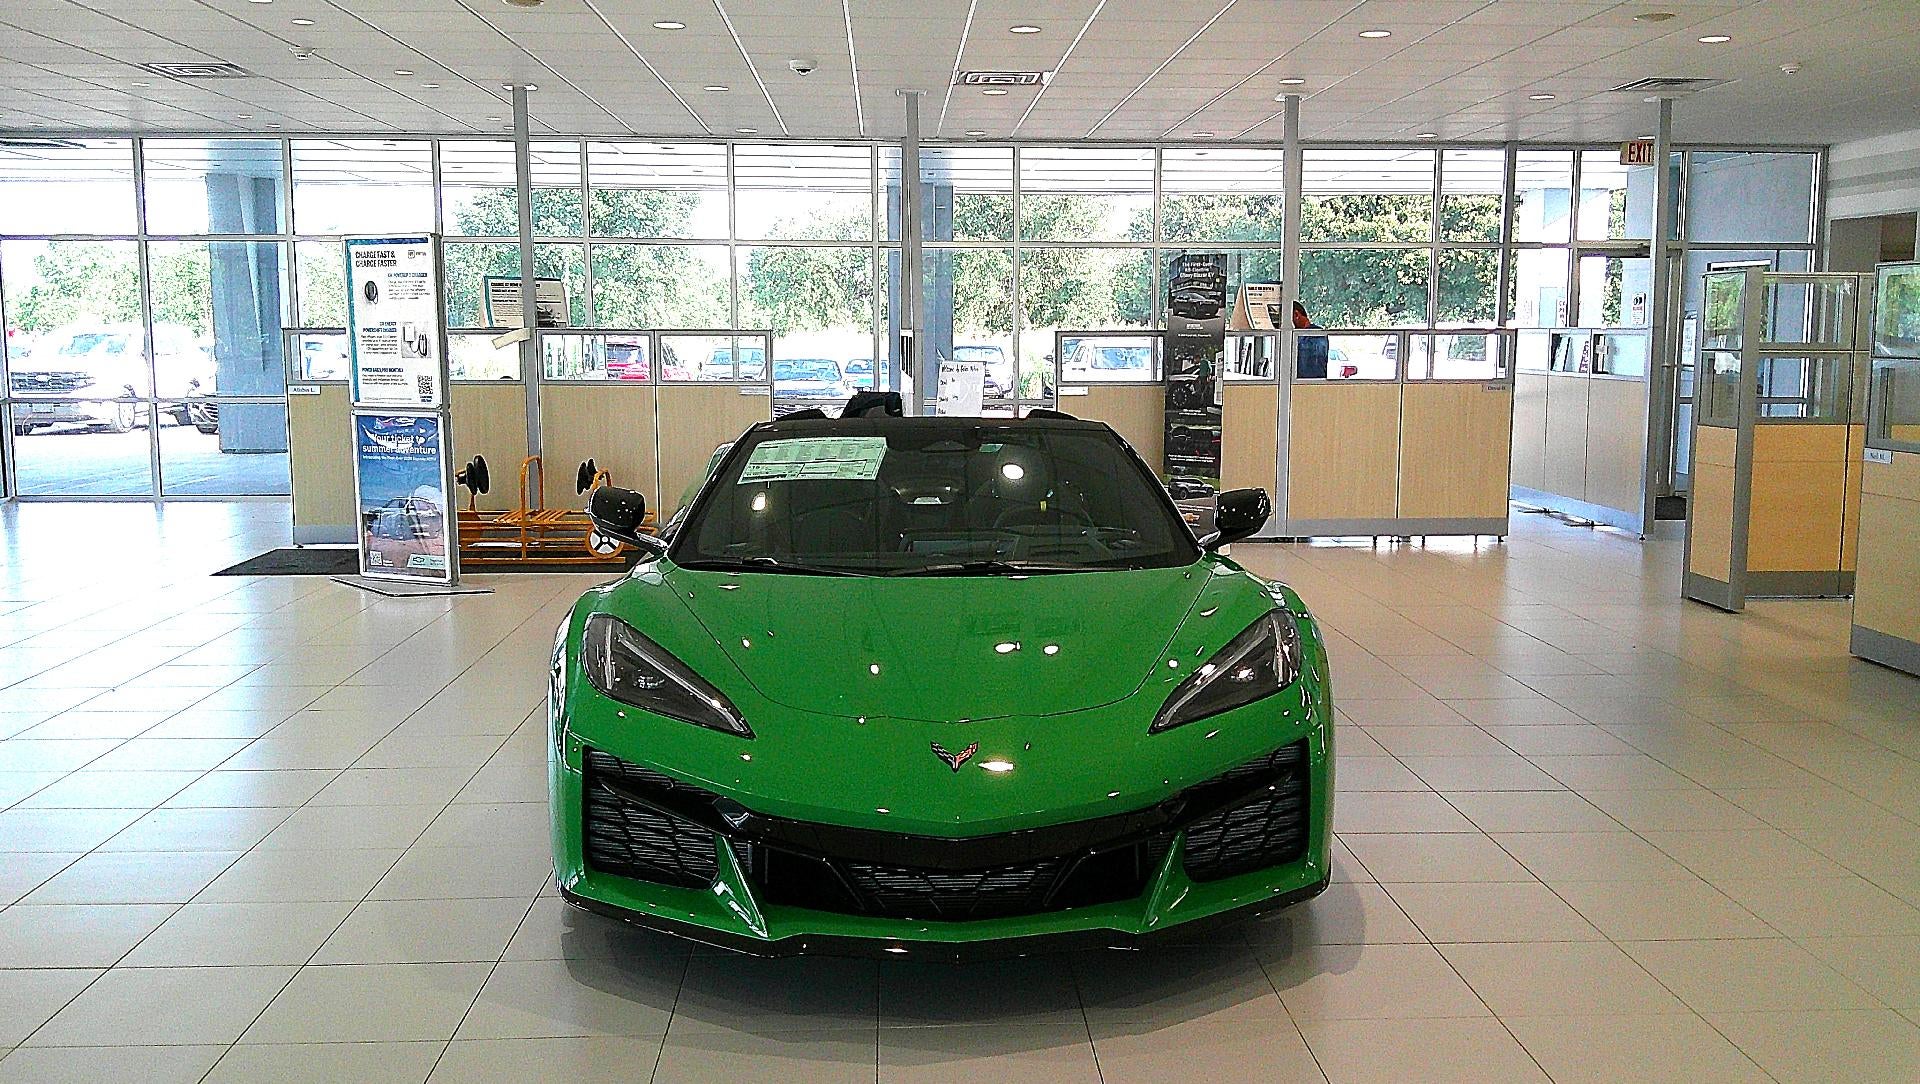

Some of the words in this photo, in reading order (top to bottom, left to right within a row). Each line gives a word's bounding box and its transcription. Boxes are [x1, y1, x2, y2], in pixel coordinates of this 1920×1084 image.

[1628, 143, 1654, 162] EXIT
[355, 251, 376, 259] CHARGE
[377, 251, 390, 259] FAST
[391, 250, 396, 258] &
[373, 434, 390, 442] Your
[391, 434, 414, 443] ticket
[415, 435, 426, 443] to
[362, 445, 393, 453] summer
[396, 446, 437, 455] adventure
